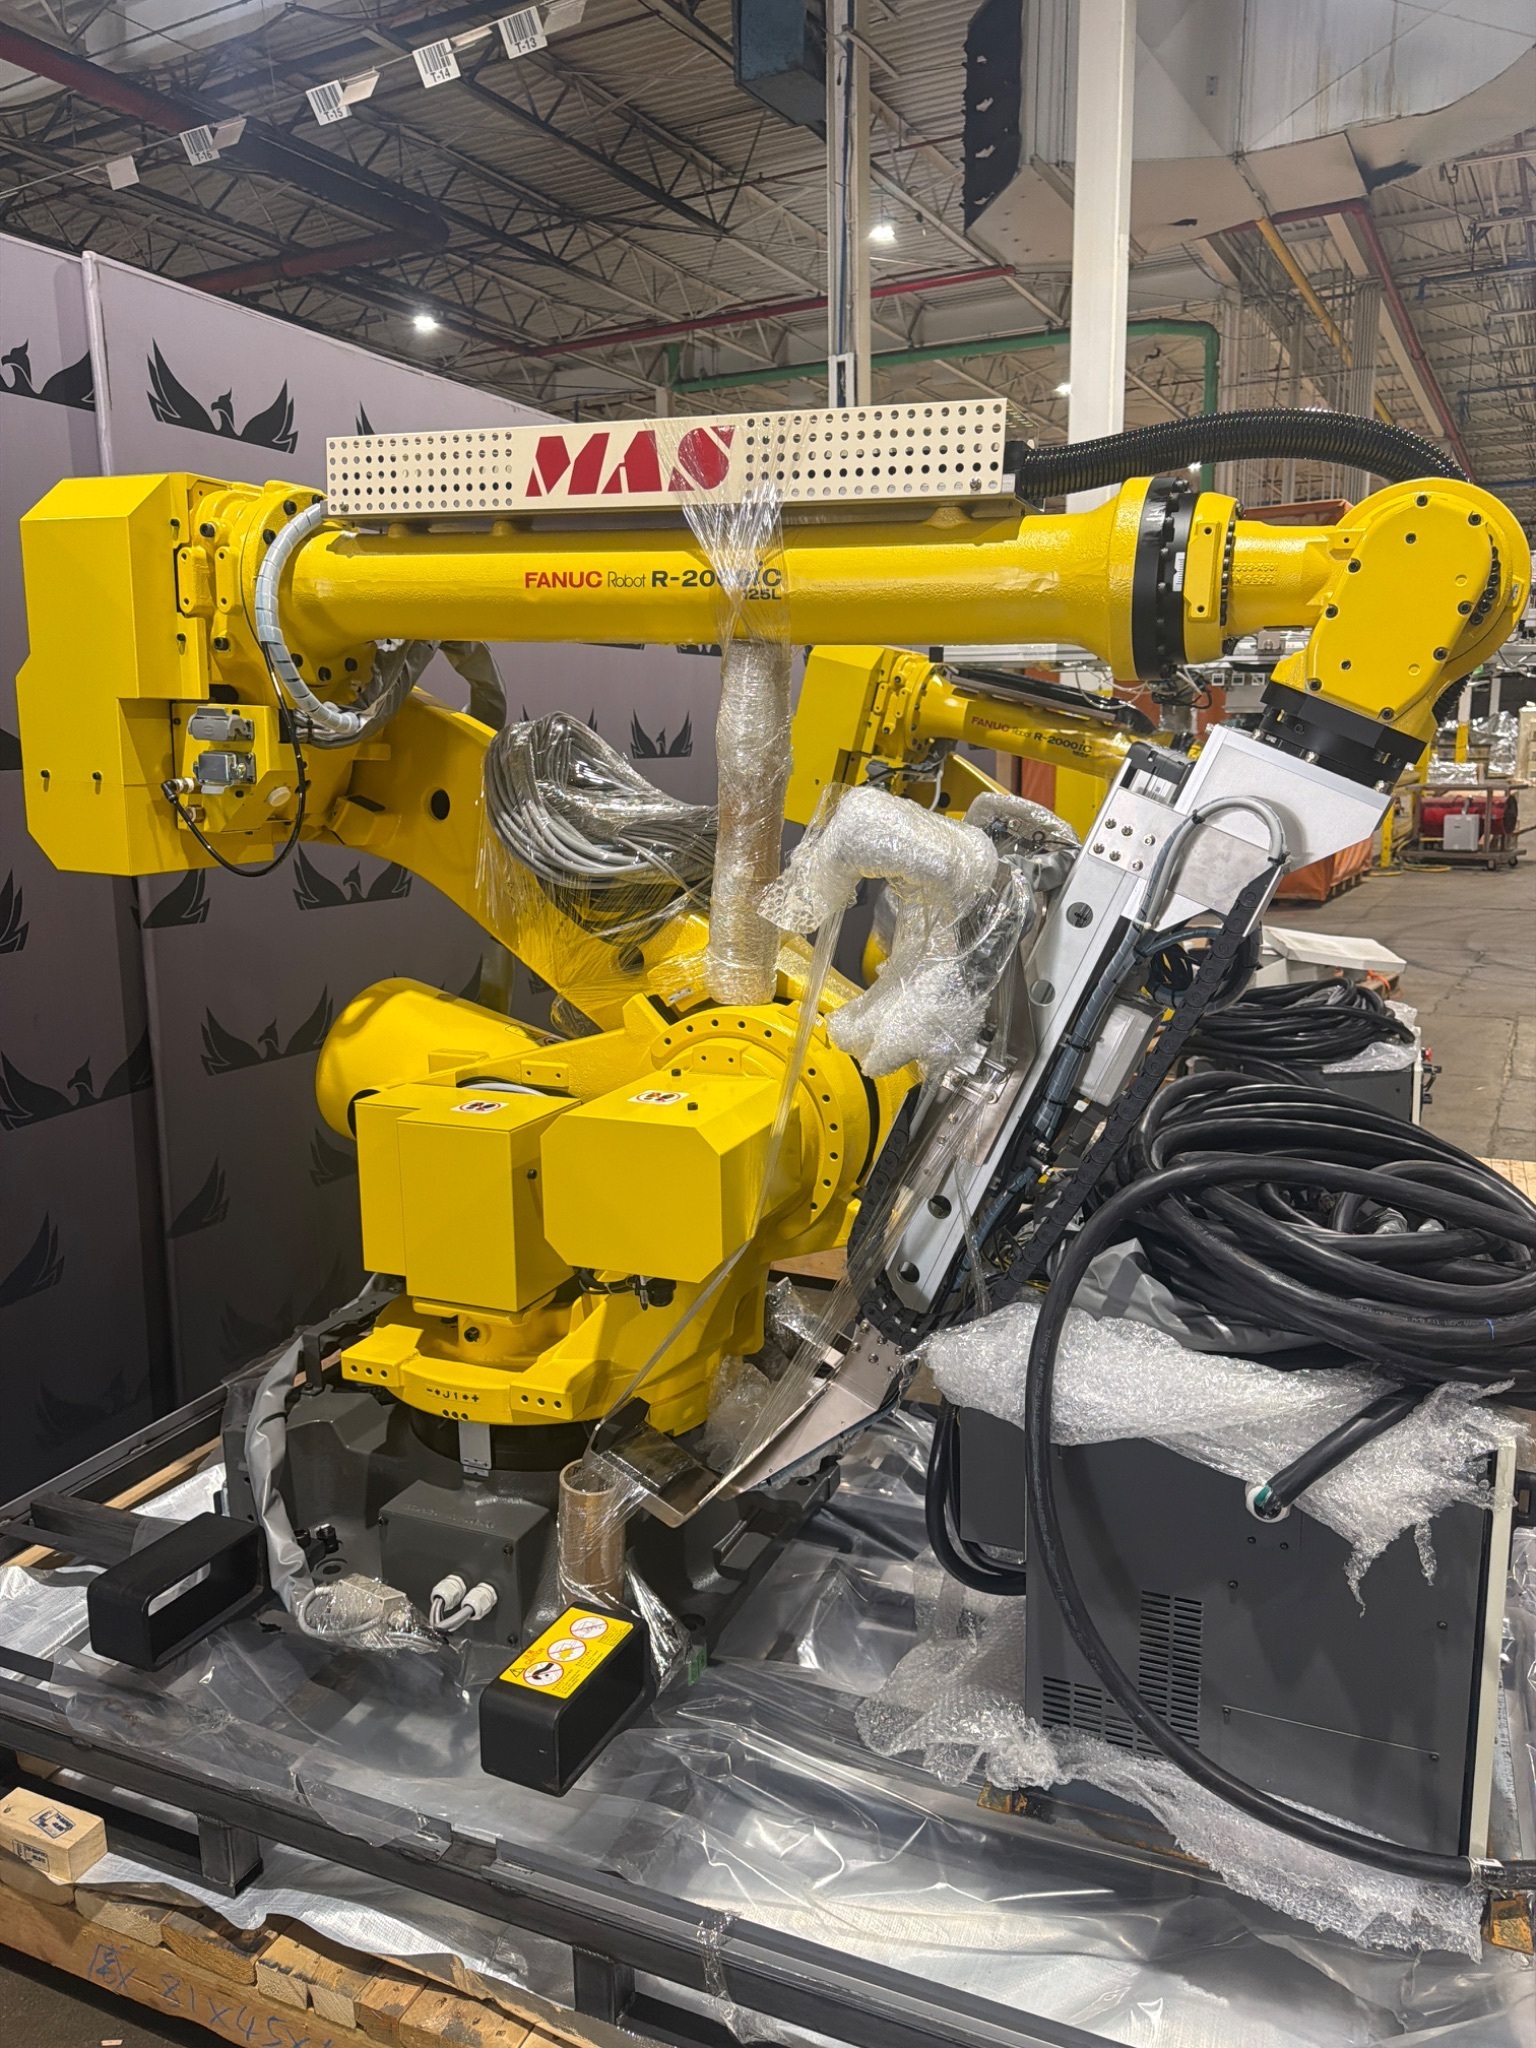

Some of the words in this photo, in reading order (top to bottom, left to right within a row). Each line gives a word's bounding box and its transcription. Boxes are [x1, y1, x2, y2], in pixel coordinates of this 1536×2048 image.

[515, 37, 537, 53] T-13
[430, 67, 451, 82] T-14
[323, 107, 343, 121] T-15
[195, 150, 212, 162] T-16
[525, 425, 736, 497] MAS
[524, 571, 602, 589] FANUC
[607, 571, 646, 588] Robot
[971, 716, 1009, 732] FANUC
[1034, 732, 1092, 754] R-2000iC
